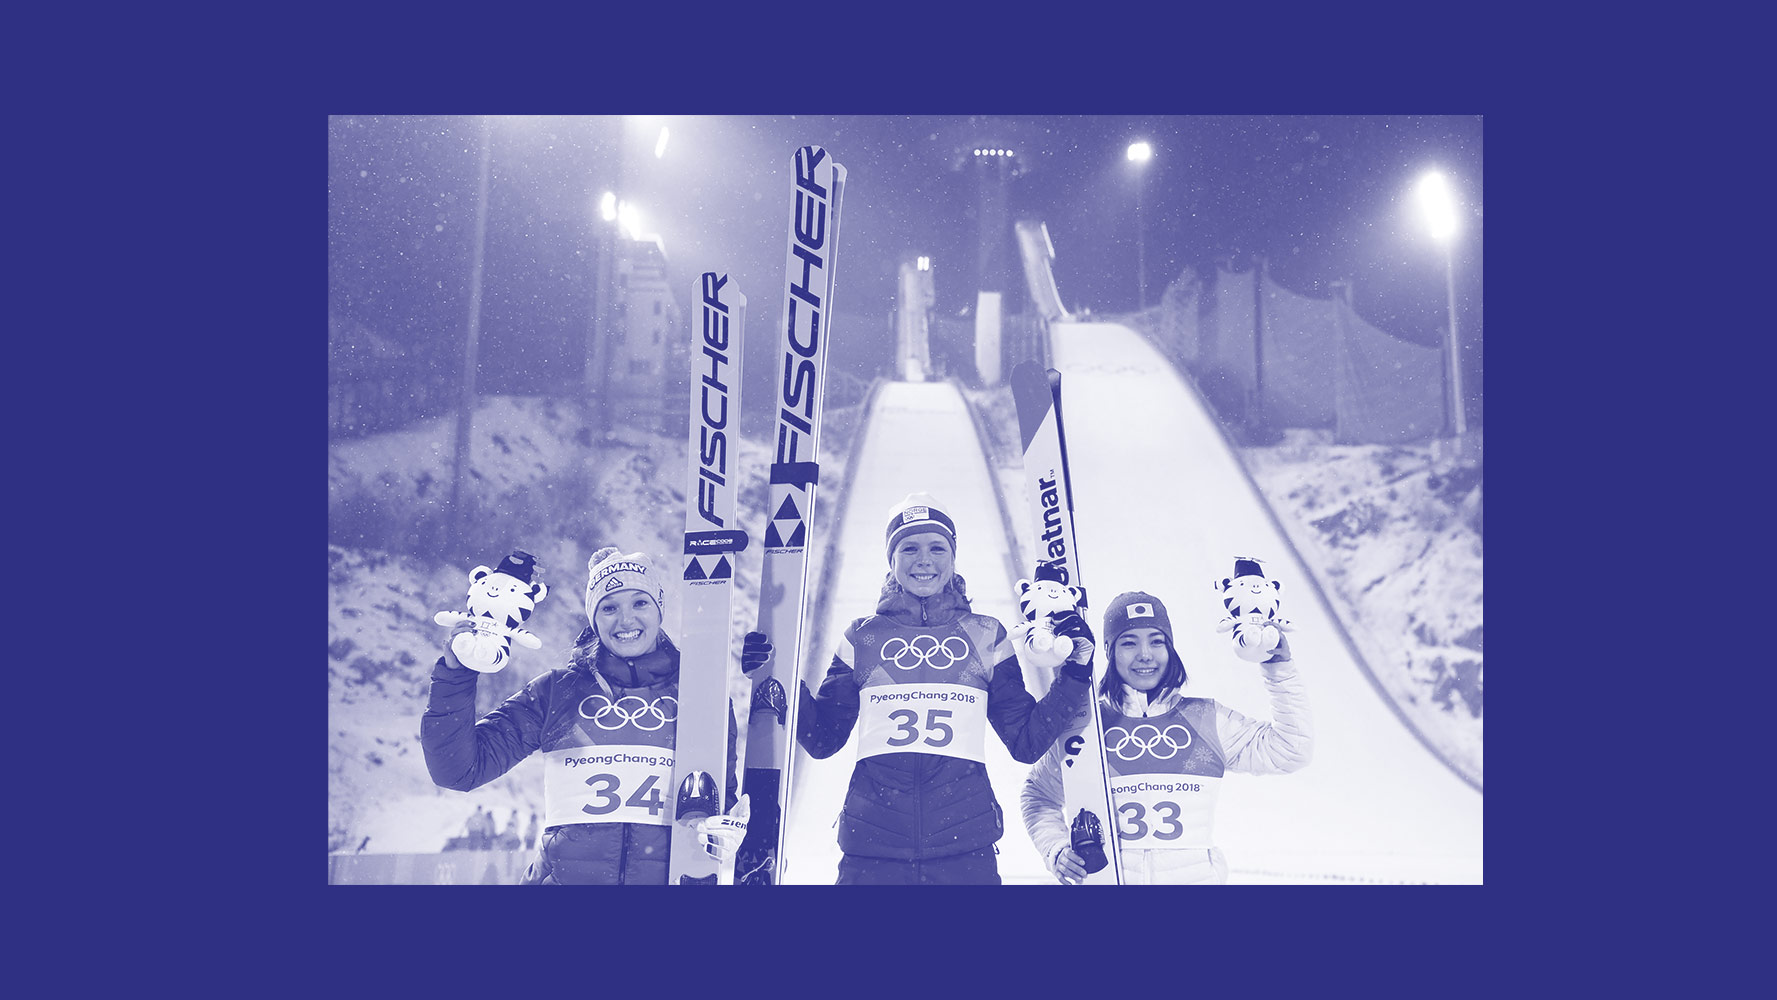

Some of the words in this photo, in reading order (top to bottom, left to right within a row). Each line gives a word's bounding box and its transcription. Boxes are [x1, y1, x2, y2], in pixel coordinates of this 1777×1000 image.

[776, 145, 827, 491] FISCHER
[698, 271, 729, 528] FISCHER
[870, 691, 948, 704] PyeongChang
[950, 692, 975, 703] 2018
[886, 708, 954, 748] 35
[564, 753, 657, 767] PyeongChang
[581, 773, 665, 816] 34
[1175, 782, 1200, 792] 2018
[1118, 801, 1183, 841] 33
